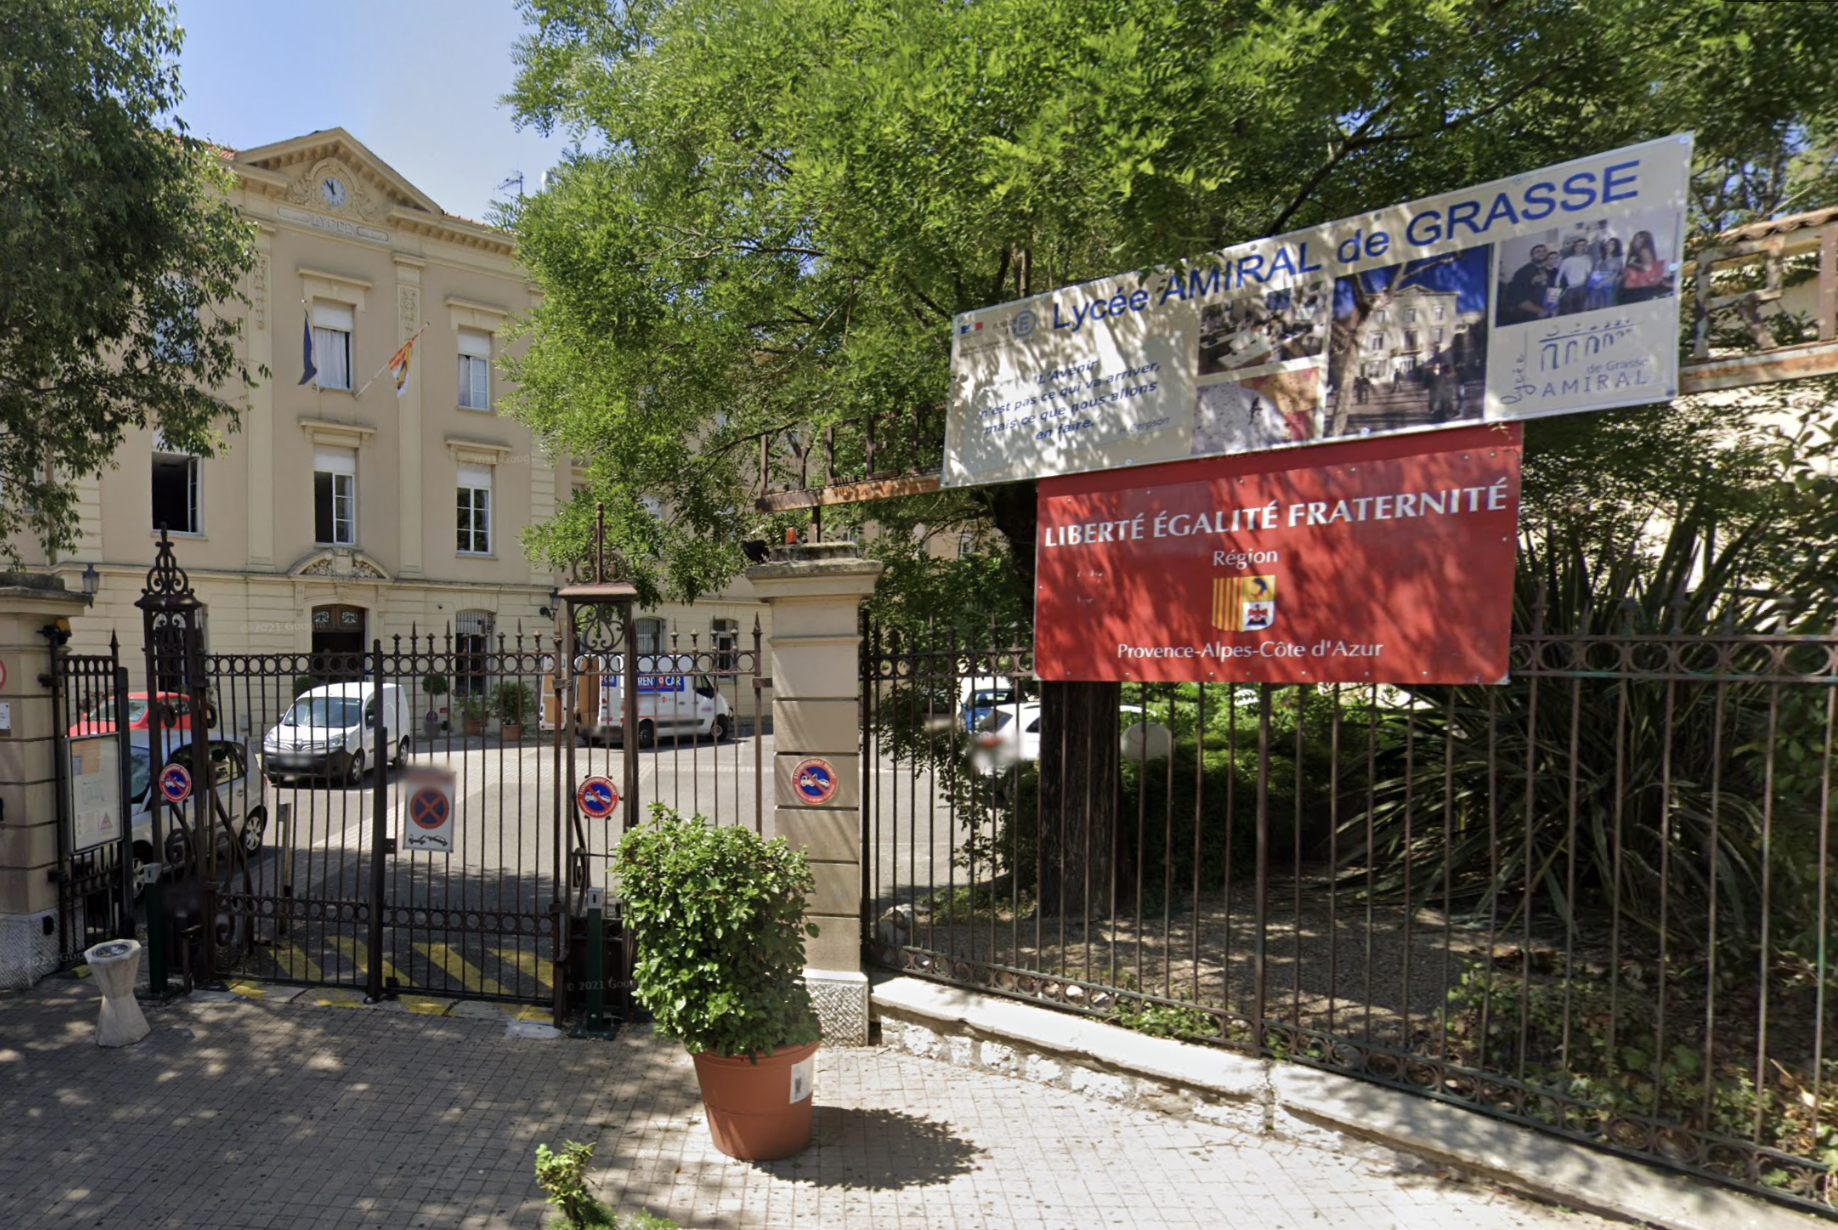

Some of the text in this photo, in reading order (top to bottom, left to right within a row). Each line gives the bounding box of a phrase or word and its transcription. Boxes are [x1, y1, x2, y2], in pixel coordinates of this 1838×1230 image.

[1053, 160, 1640, 333] Lycée AMIRAL de GRASSE
[1587, 363, 1603, 374] de
[979, 361, 1161, 420] n'est pas ce qui va arriver,
[1541, 370, 1647, 397] AMIRAL
[984, 381, 1158, 435] mais ce que nous allons
[1036, 419, 1094, 441] en faire.
[1130, 416, 1170, 434] Bergson
[1045, 477, 1508, 548] LIBERTÉ ÉGALITÉ FRATERNITÉ
[1213, 547, 1279, 571] Région
[1117, 640, 1384, 660] Provence-Alpes-Côte d'Azur
[637, 677, 658, 687] REN
[665, 676, 682, 686] CAR
